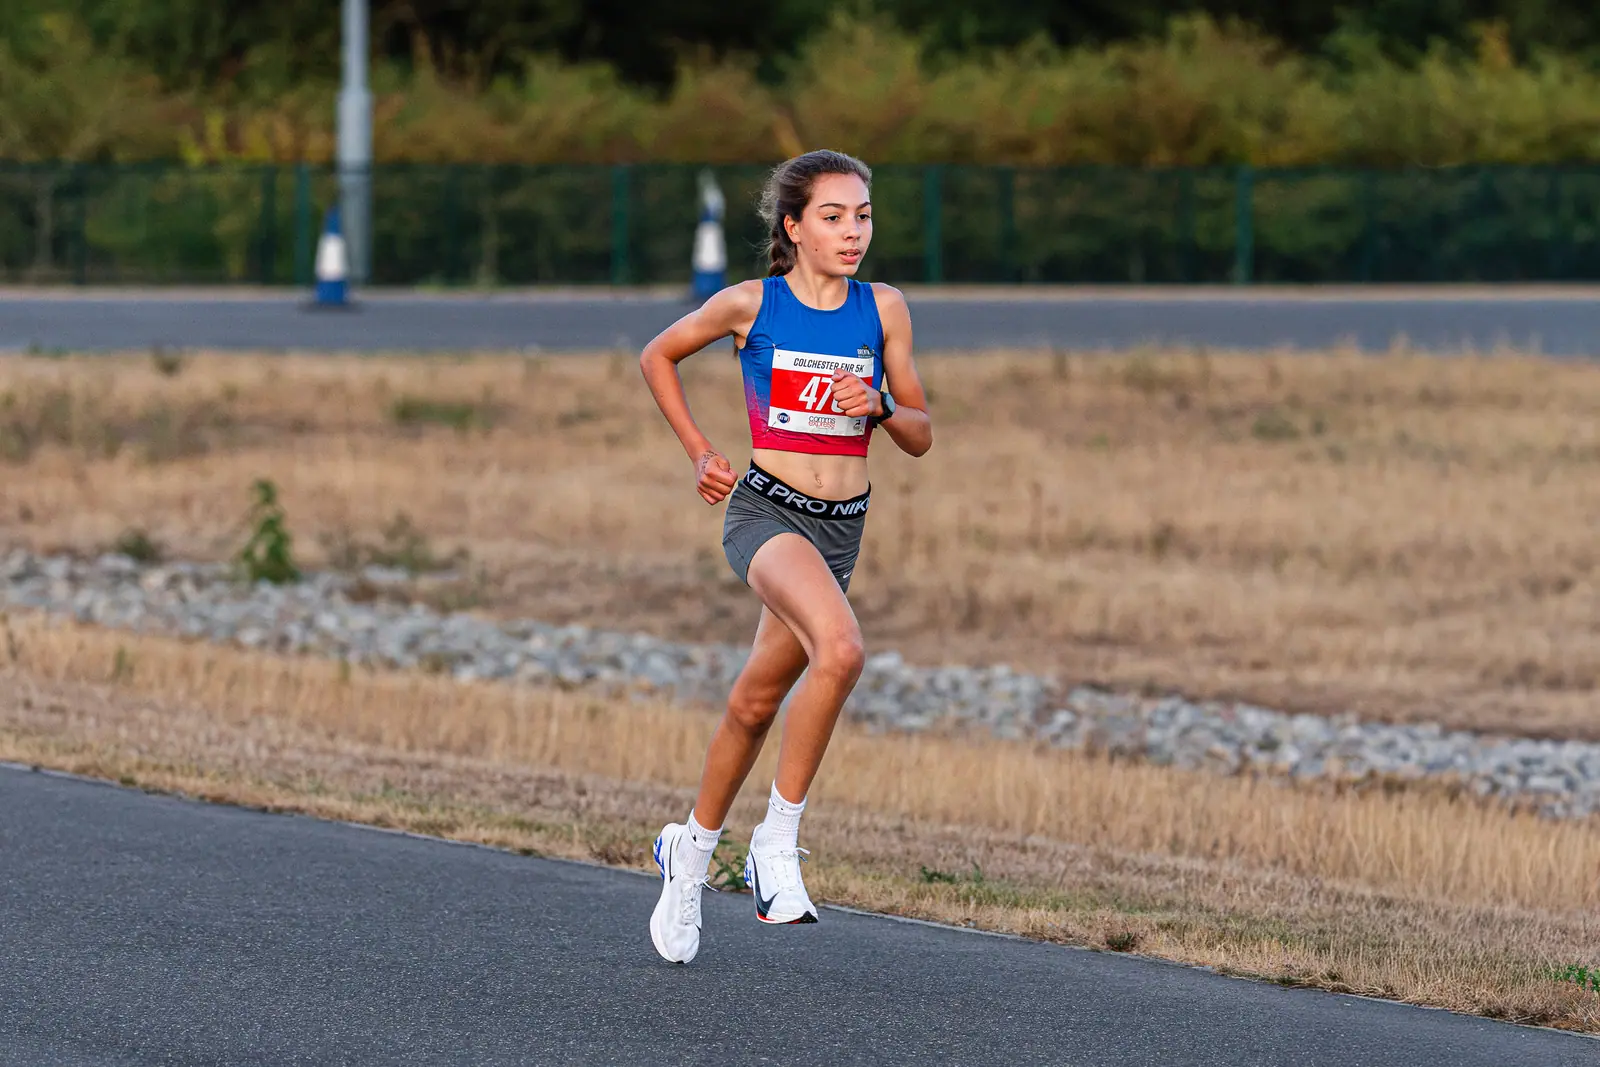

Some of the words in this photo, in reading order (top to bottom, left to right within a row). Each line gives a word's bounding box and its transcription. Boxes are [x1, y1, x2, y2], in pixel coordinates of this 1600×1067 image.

[793, 357, 840, 370] COLCHESTER
[855, 364, 865, 373] 5K
[808, 415, 836, 424] comms
[767, 483, 828, 513] PRO
